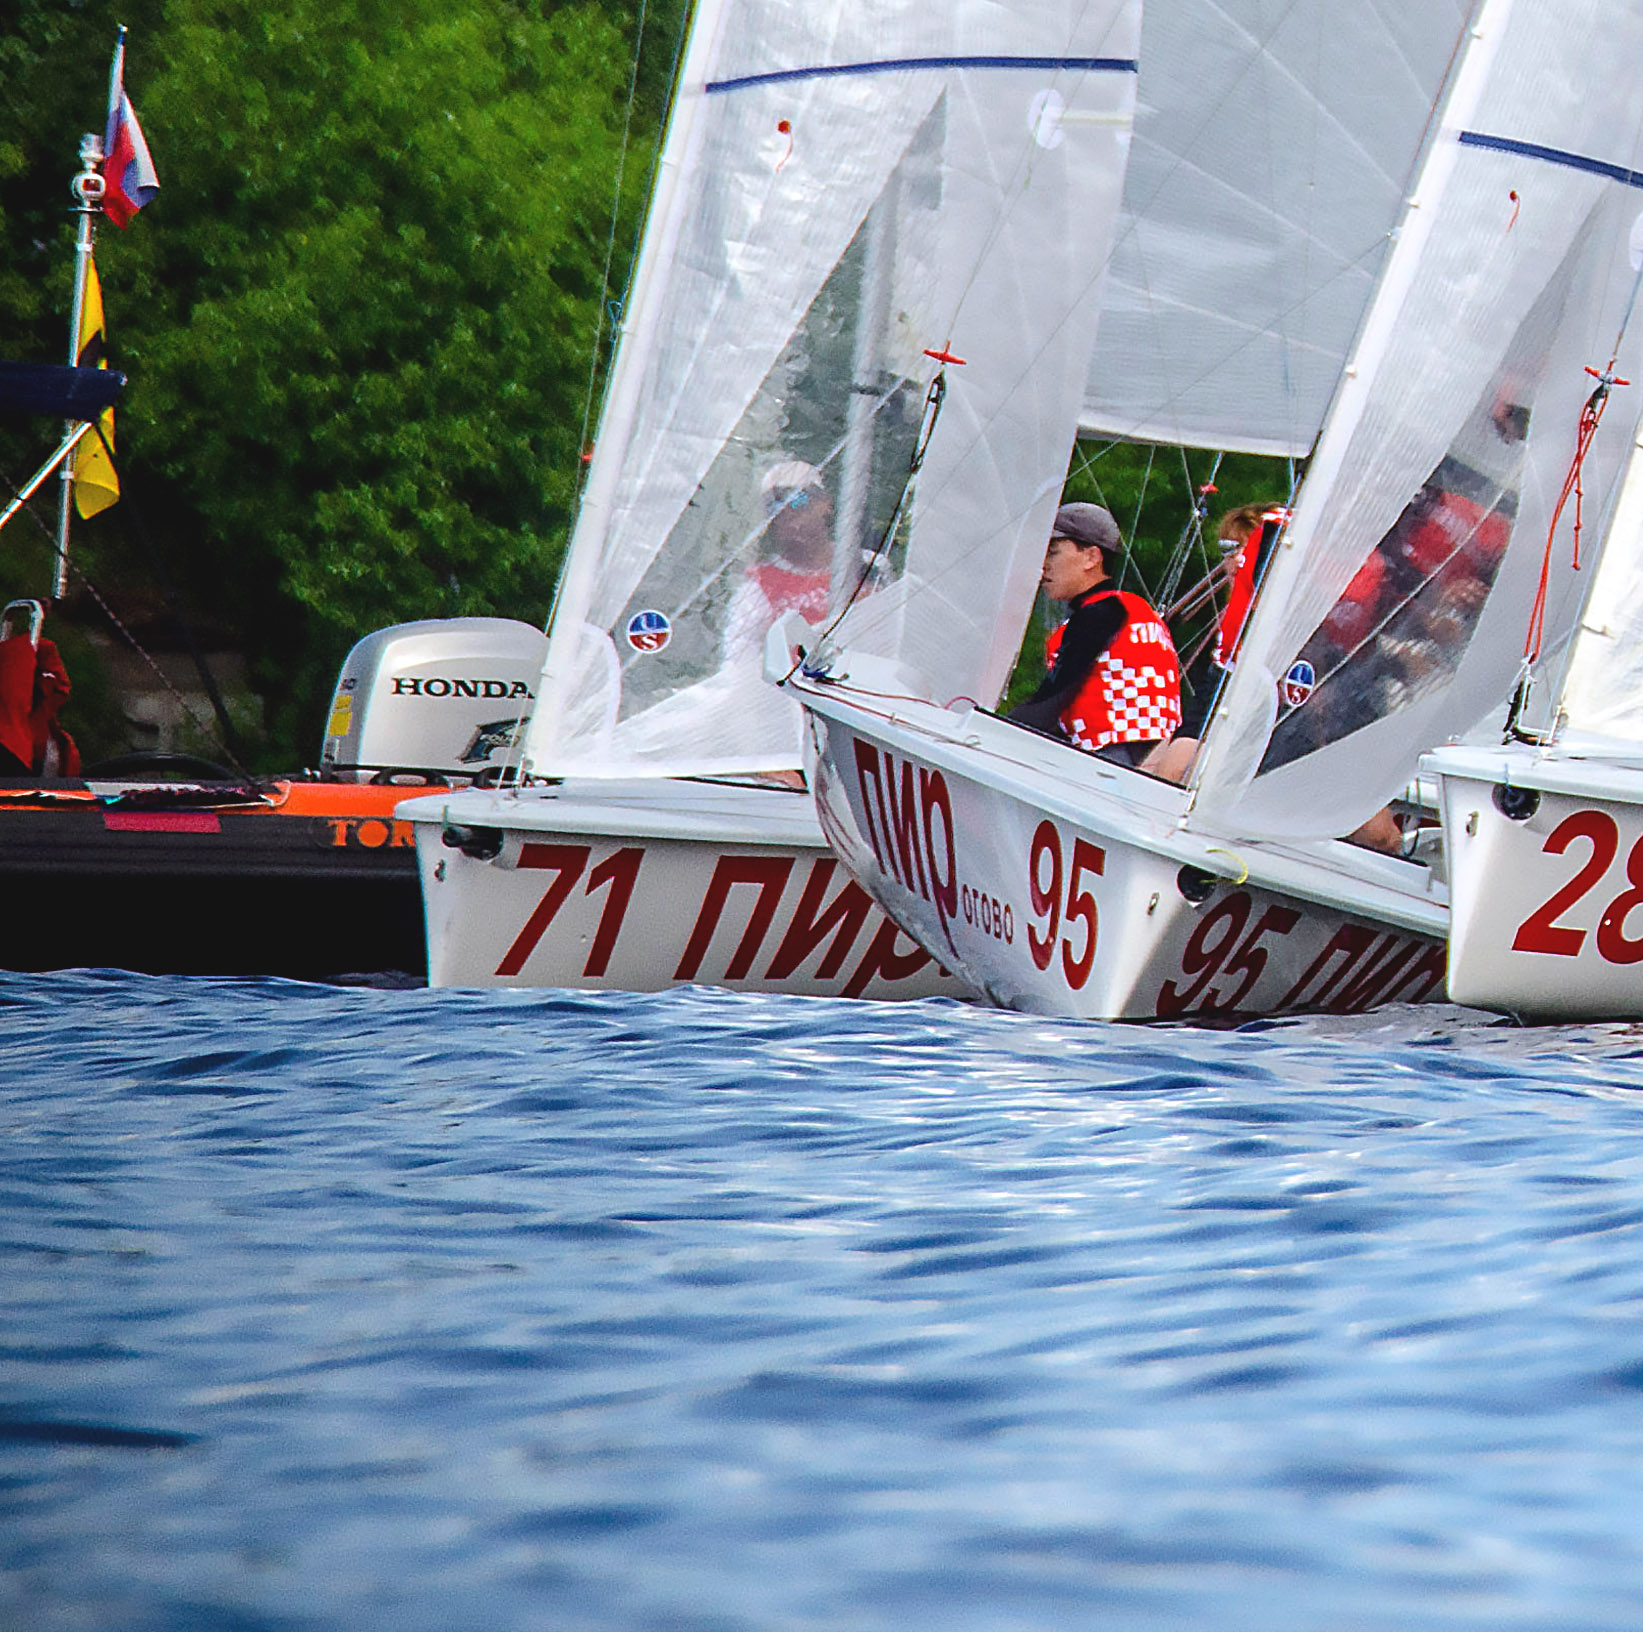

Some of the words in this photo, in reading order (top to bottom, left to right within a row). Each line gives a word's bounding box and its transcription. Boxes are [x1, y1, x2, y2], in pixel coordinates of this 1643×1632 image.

[391, 676, 536, 699] HONDA
[494, 842, 646, 978] 71
[1026, 818, 1107, 991] 95
[1156, 891, 1301, 1018] 95
